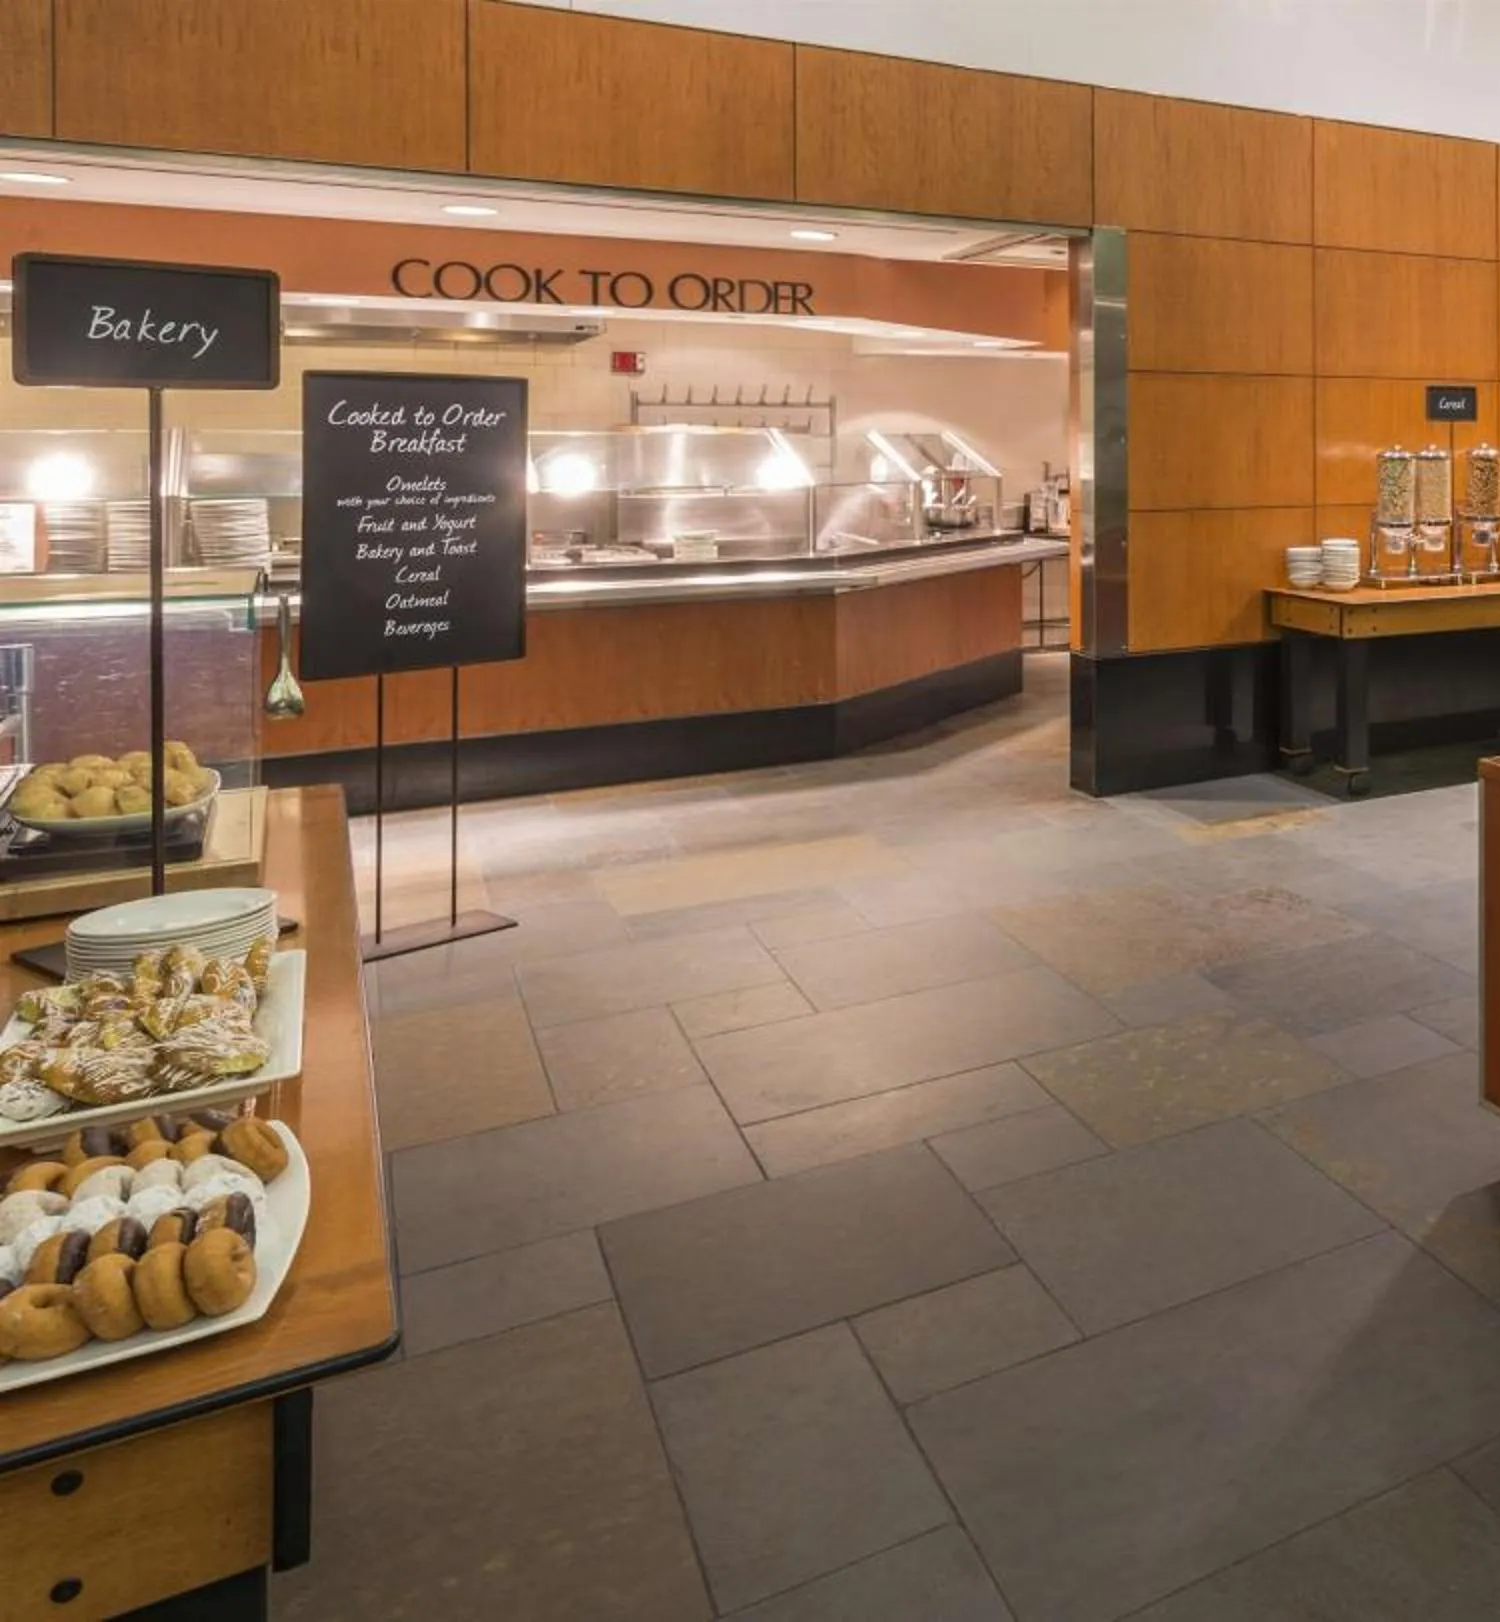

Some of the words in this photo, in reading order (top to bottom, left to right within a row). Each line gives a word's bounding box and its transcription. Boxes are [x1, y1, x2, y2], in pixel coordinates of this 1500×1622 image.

[392, 258, 564, 305] COOK
[579, 269, 654, 309] TO
[668, 272, 816, 315] ORDER
[87, 305, 220, 360] Bakery
[327, 400, 407, 426] Cooked
[413, 405, 436, 426] to
[441, 403, 507, 427] Order
[1439, 396, 1467, 410] Cereal
[369, 428, 468, 454] Breakfast
[385, 474, 448, 492] Omelets
[336, 496, 363, 508] with
[365, 496, 391, 511] your
[394, 494, 426, 506] choice
[429, 491, 442, 505] of
[357, 515, 395, 534] Fruit
[401, 517, 428, 531] and
[432, 513, 477, 536] Yogurt
[355, 543, 404, 564] Bakery
[409, 543, 436, 557] and
[440, 536, 478, 556] Toast
[394, 565, 442, 584] Cereal
[385, 590, 450, 610] Oatmeal
[383, 620, 450, 640] Beverages
